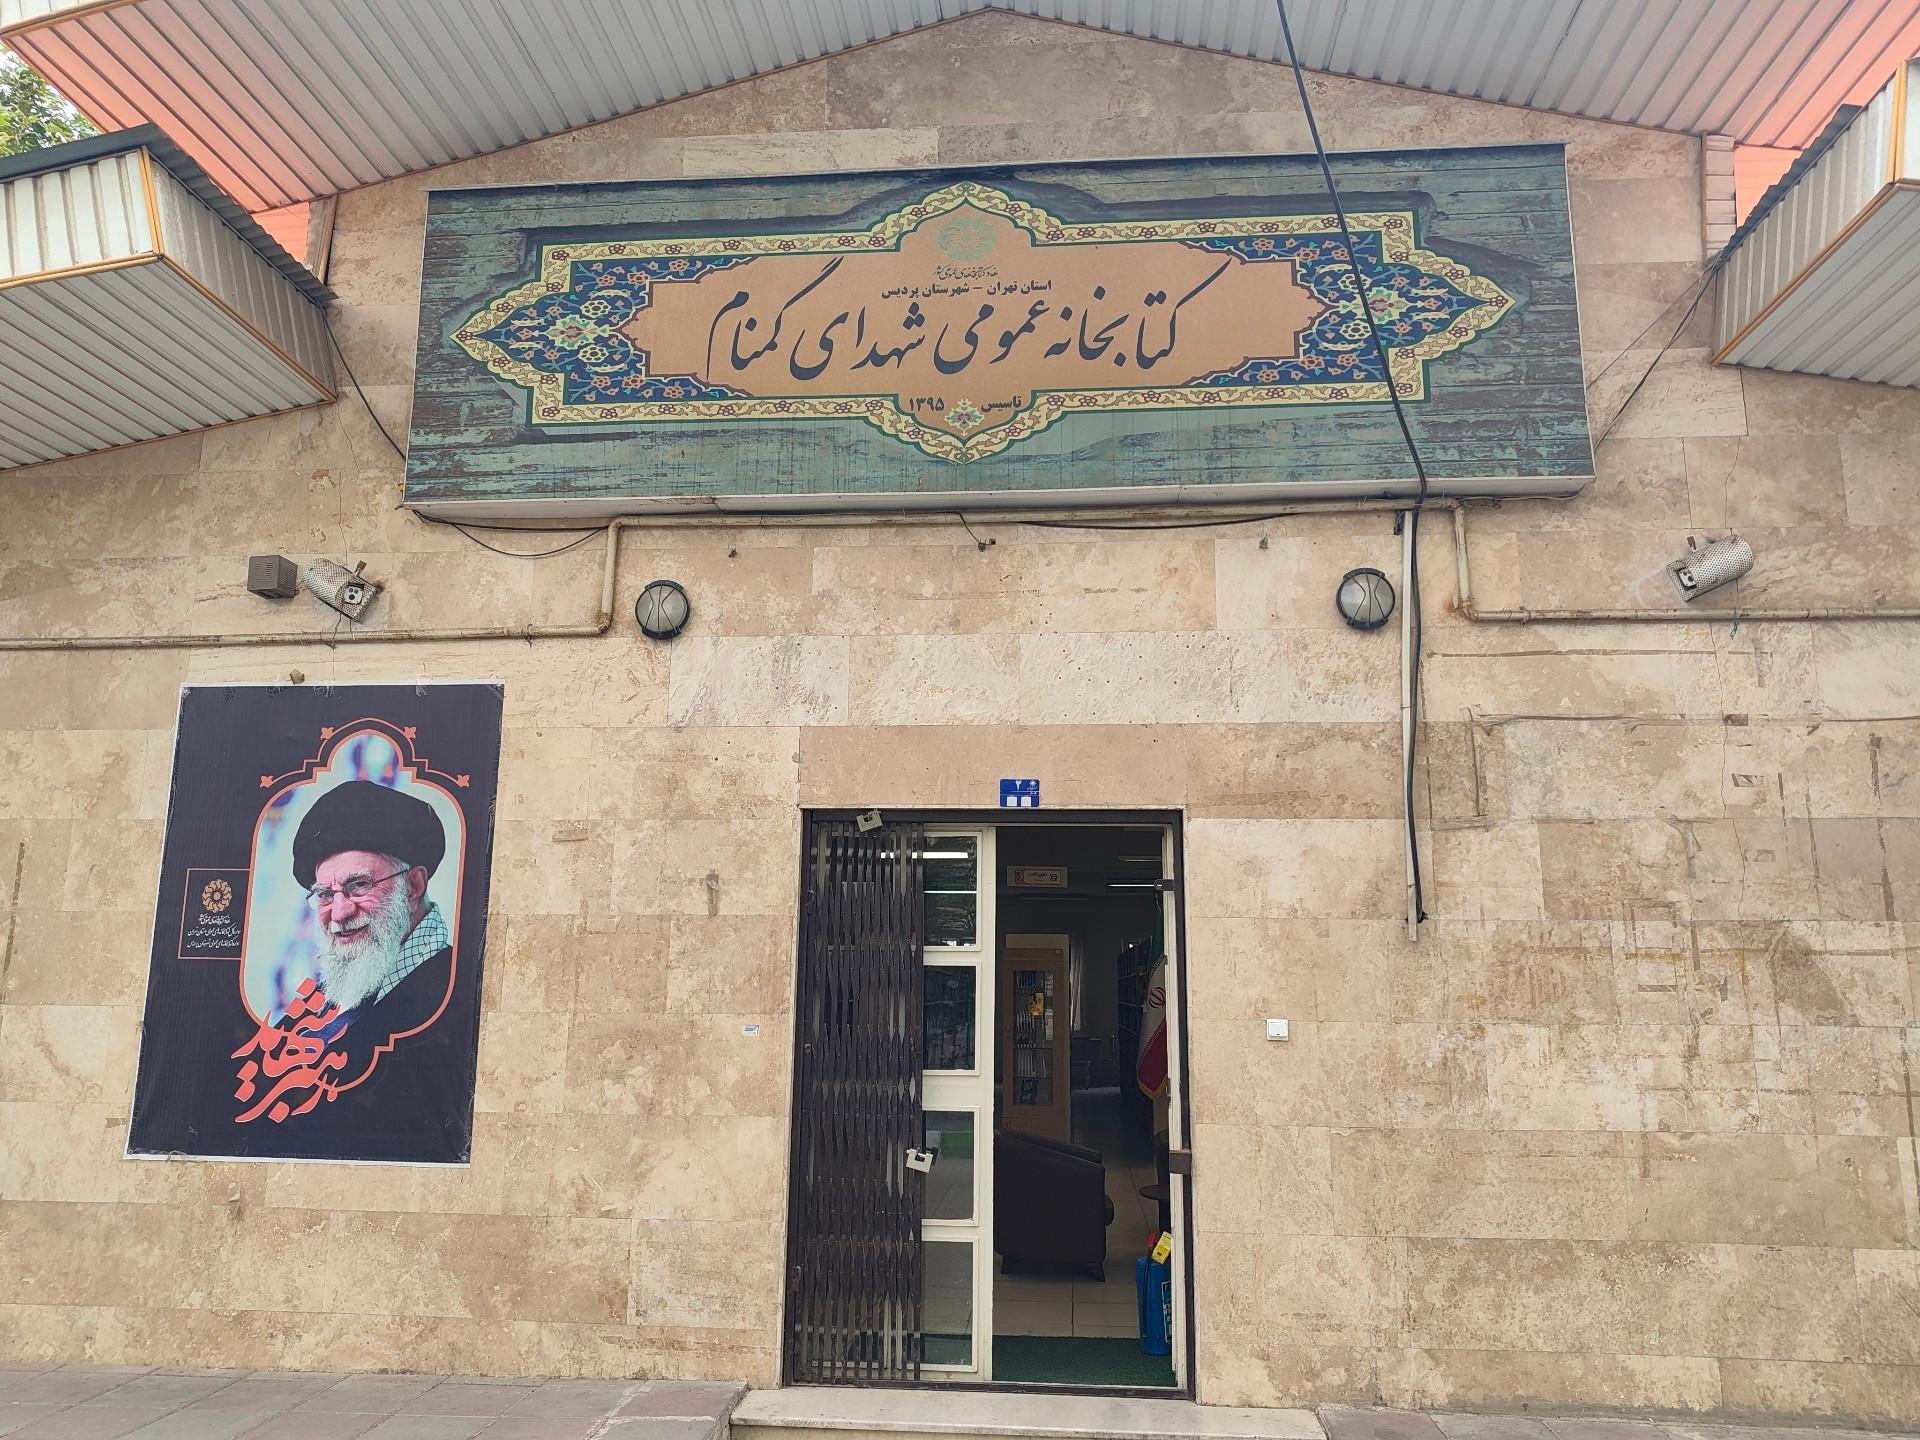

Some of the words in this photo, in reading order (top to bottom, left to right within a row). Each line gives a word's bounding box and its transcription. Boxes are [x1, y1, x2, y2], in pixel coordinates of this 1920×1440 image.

[881, 285, 919, 300] پردیس
[921, 283, 970, 298] شهرستان
[986, 280, 1018, 296] تهران
[1020, 279, 1052, 294] استان
[706, 255, 845, 381] گمنام
[934, 299, 1050, 375] عمومی
[1044, 257, 1233, 370] کتابخانه
[789, 301, 926, 381] شهدای
[909, 397, 945, 412] ۱۳۹۵
[980, 395, 1022, 413] تاسیس
[230, 976, 343, 1103] شهید
[234, 1022, 349, 1124] رهبر
